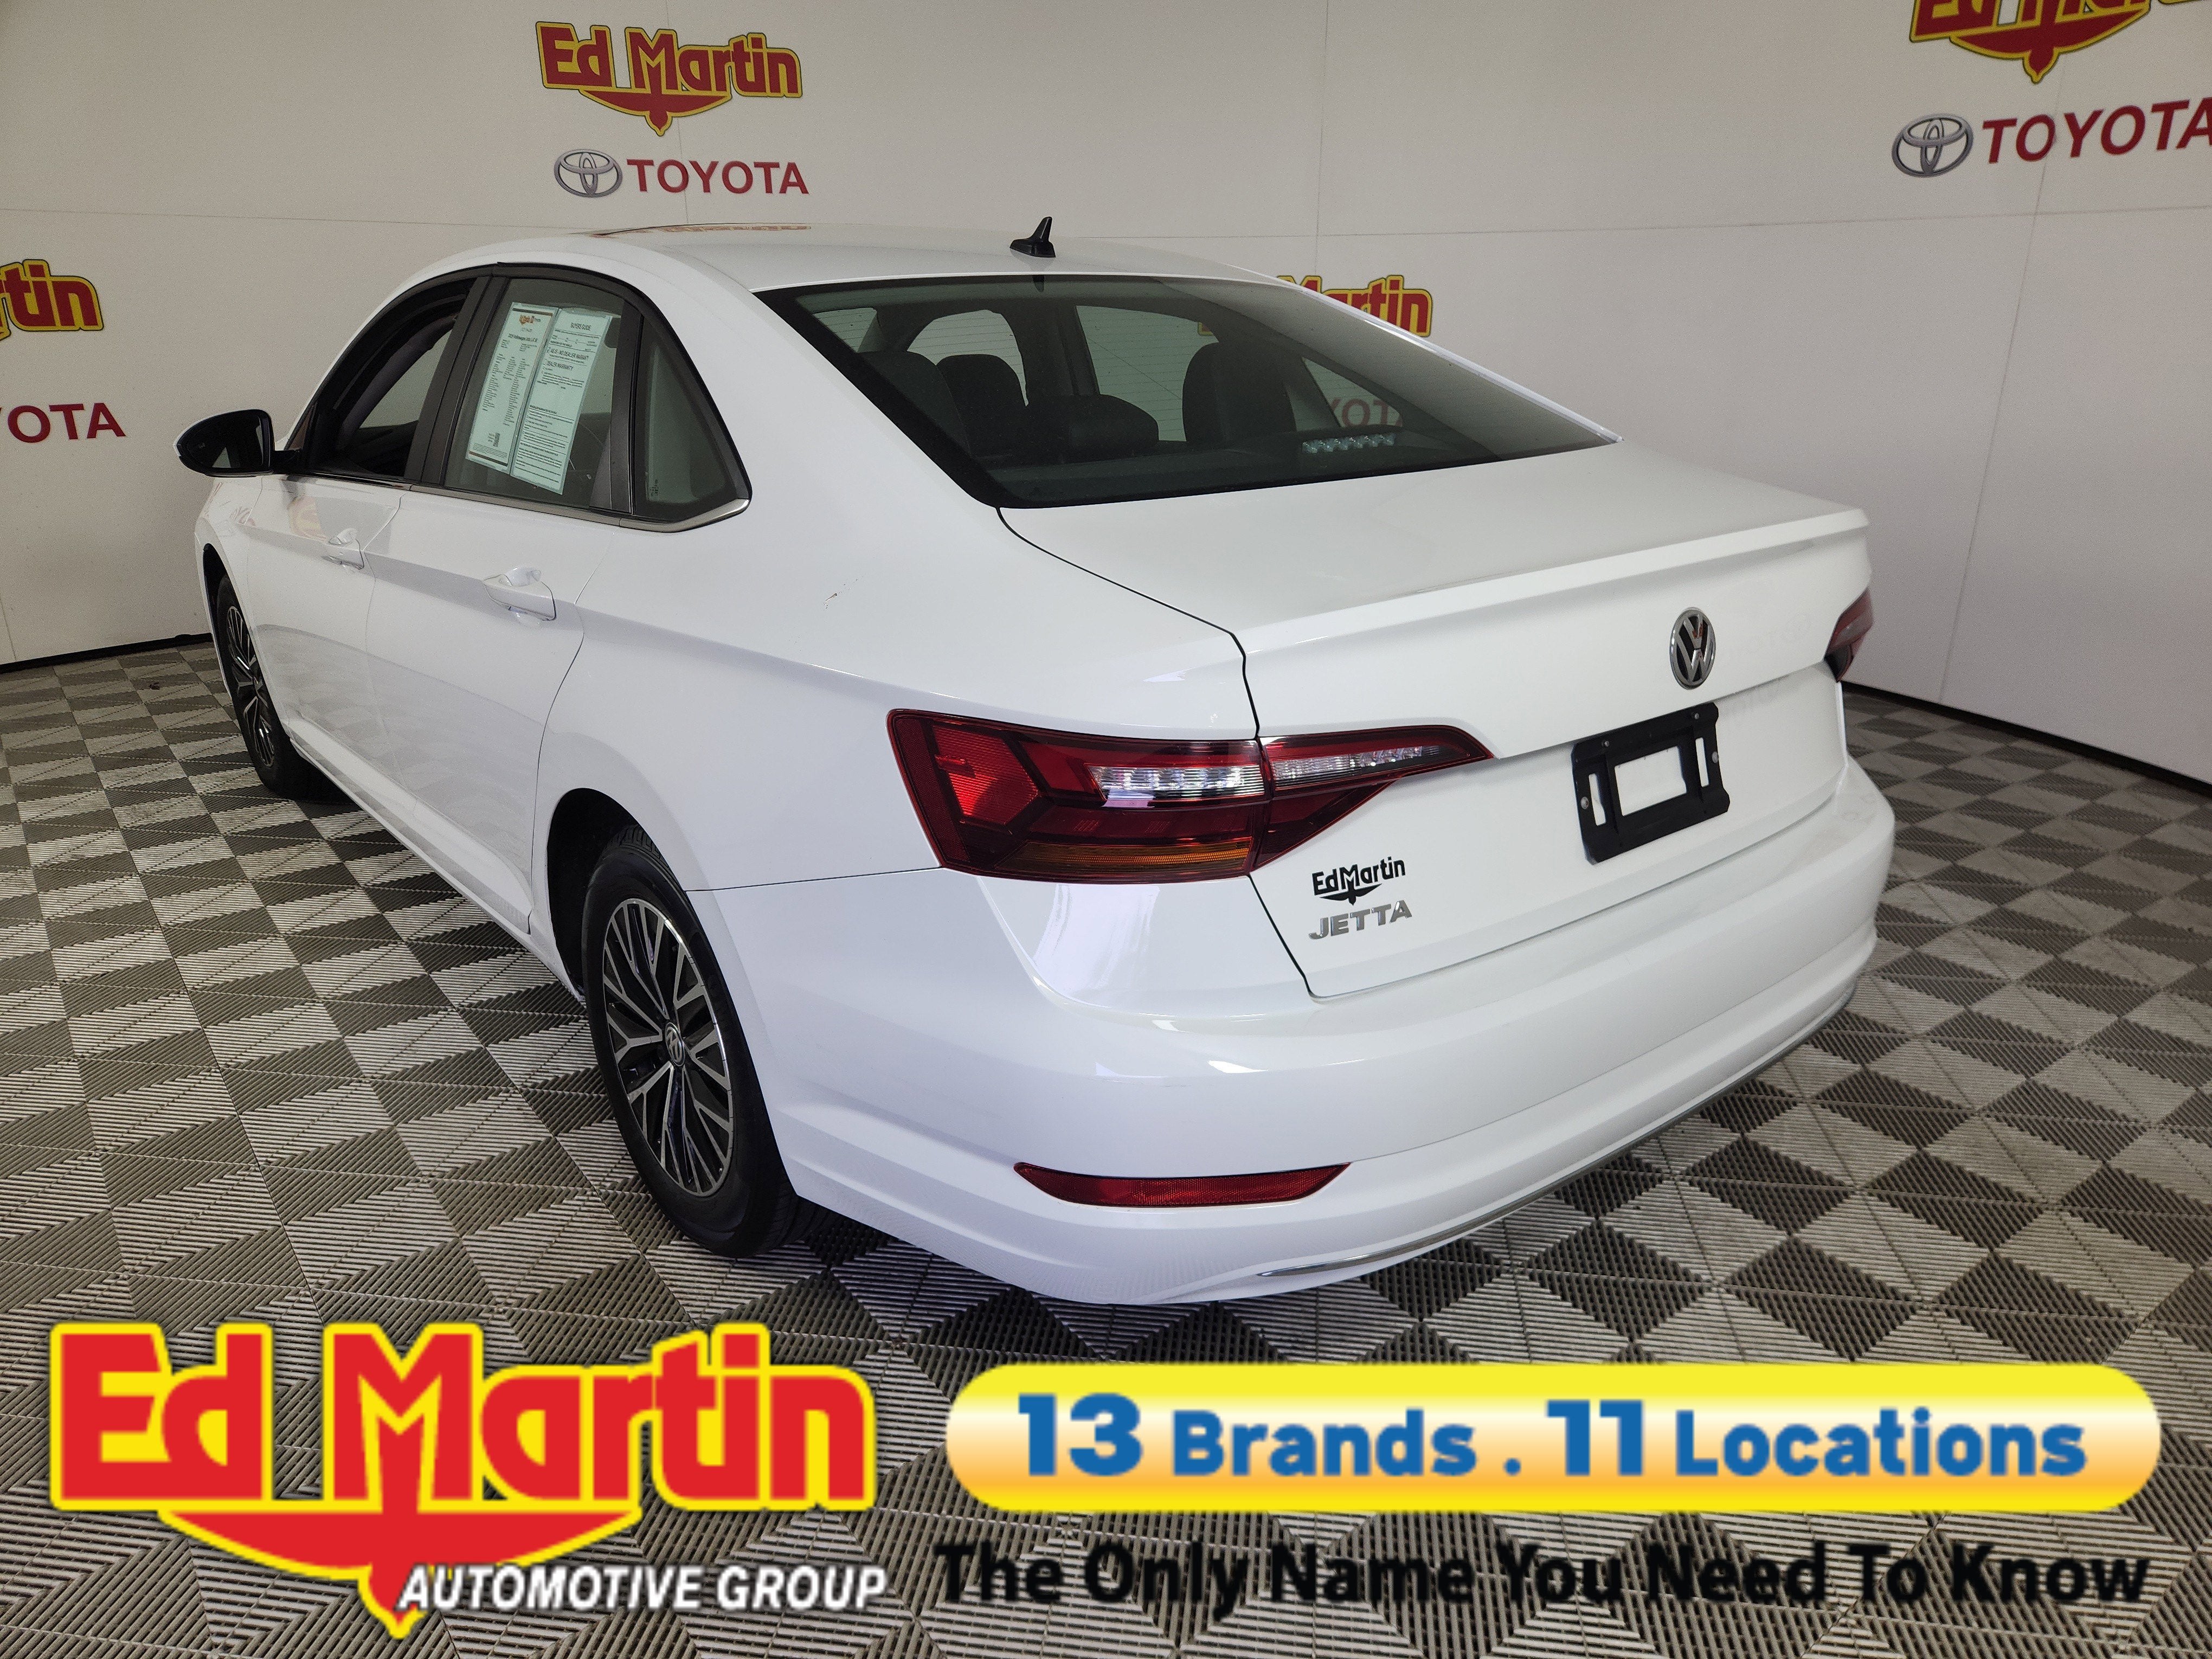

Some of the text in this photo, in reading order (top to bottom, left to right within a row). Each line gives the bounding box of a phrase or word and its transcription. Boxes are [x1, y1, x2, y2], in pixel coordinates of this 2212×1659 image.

[536, 21, 803, 99] Ed Martin
[1982, 98, 2212, 164] TOYOTA
[627, 159, 809, 195] TOYOTA
[1308, 899, 1412, 940] JETTA
